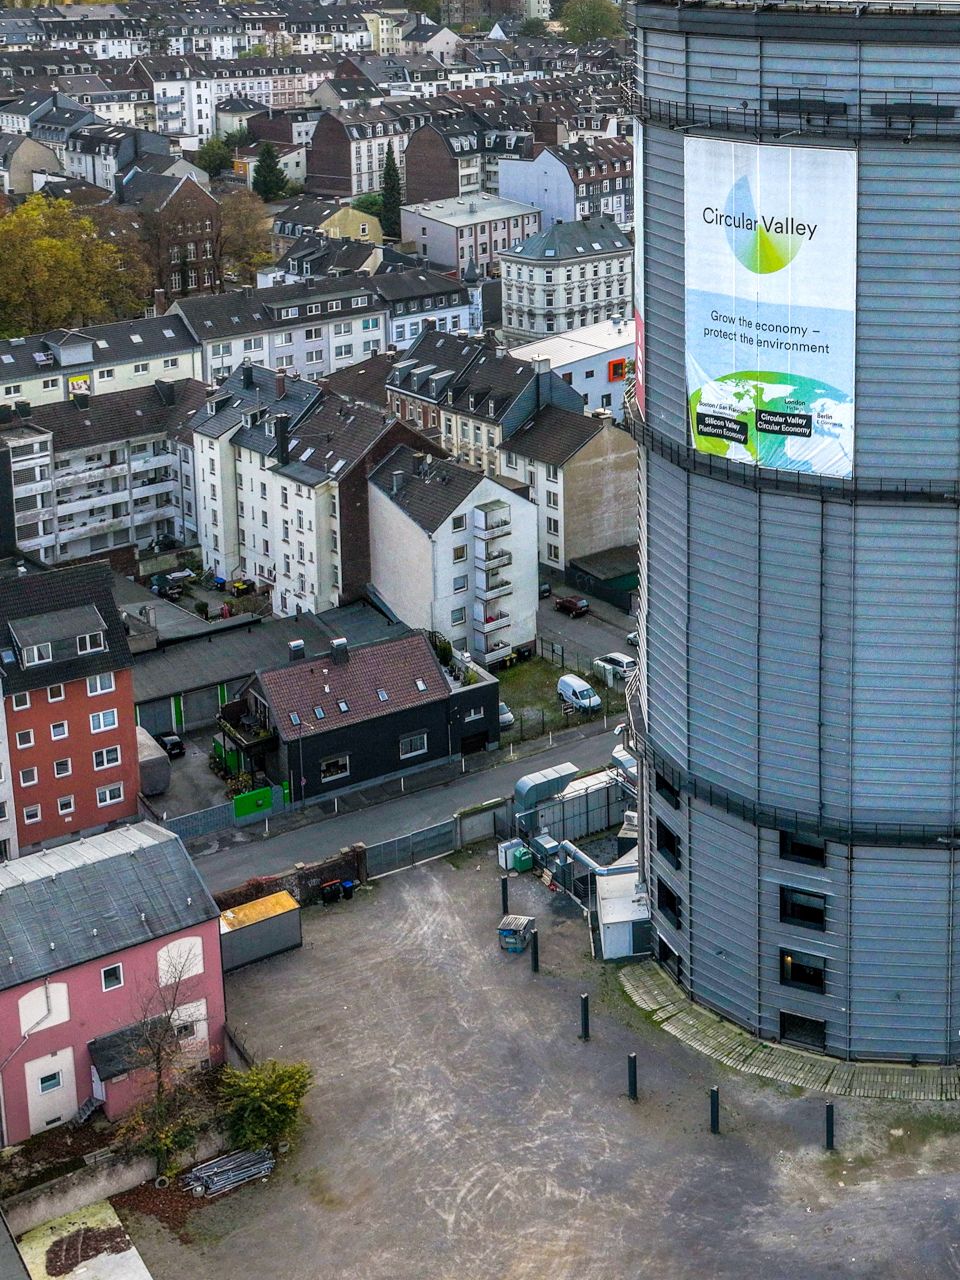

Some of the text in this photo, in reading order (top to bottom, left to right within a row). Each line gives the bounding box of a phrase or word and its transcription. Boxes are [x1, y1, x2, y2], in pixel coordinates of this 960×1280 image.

[702, 206, 818, 241] Circular Valley
[710, 309, 736, 325] Grow
[738, 315, 753, 329] the
[755, 322, 808, 338] economy
[703, 326, 830, 354] protect the environment
[784, 398, 806, 406] London
[704, 416, 741, 432] Silicon Valley
[760, 412, 807, 426] Circular Valley
[816, 412, 833, 420] Berlin
[698, 424, 746, 442] Platform Economy
[757, 421, 811, 436] Circular Economy
